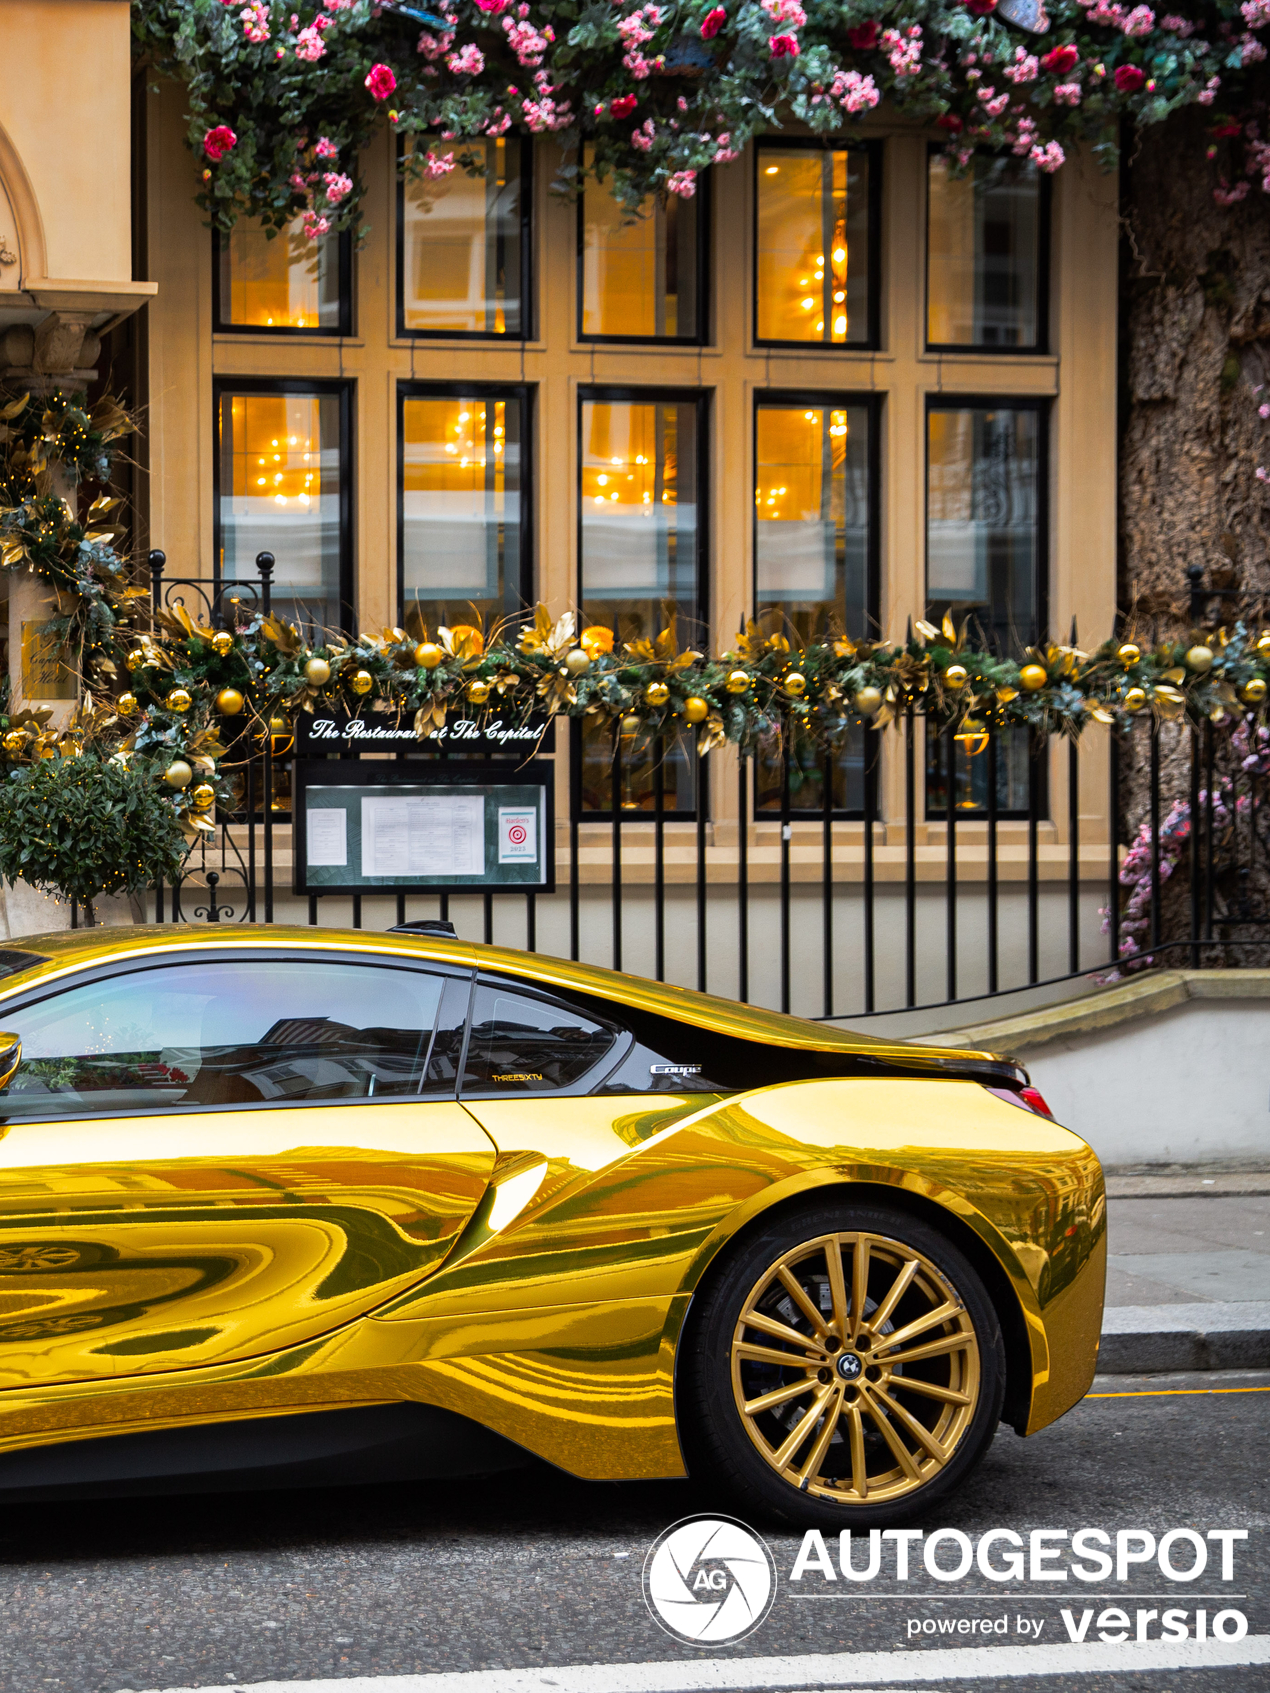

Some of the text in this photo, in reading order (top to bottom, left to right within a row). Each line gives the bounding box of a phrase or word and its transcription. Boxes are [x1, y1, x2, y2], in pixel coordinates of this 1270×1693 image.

[33, 670, 70, 684] Hotel
[309, 719, 544, 745] The Restauran at The Capital
[492, 1073, 543, 1082] THREESIXTY
